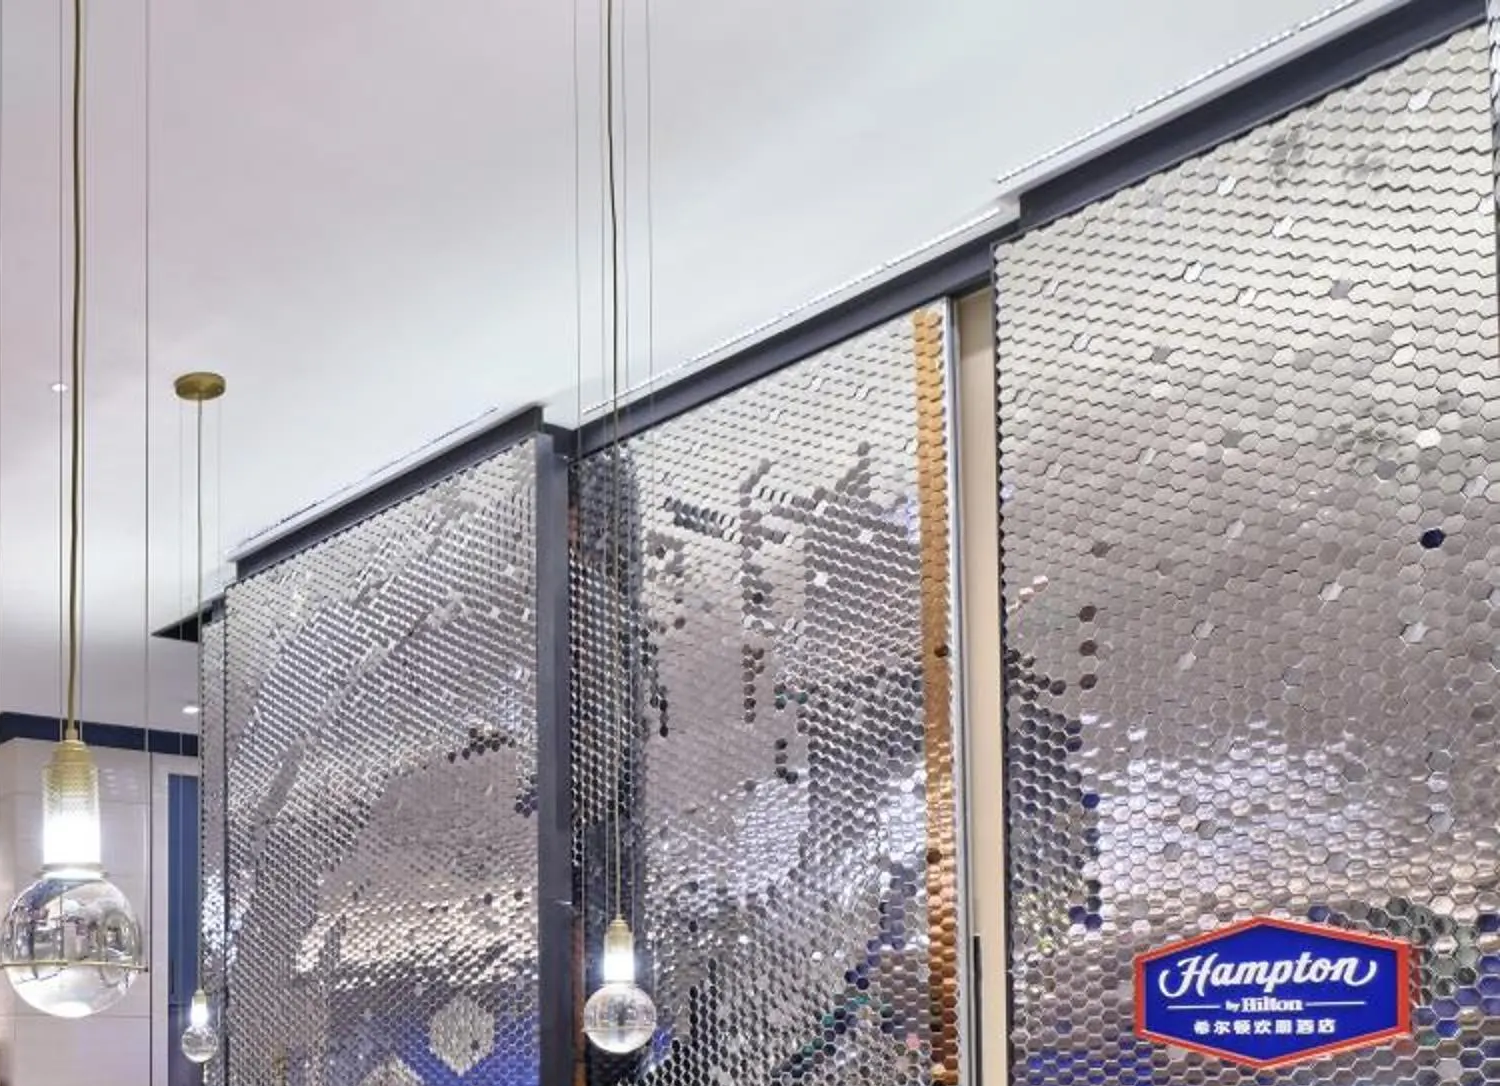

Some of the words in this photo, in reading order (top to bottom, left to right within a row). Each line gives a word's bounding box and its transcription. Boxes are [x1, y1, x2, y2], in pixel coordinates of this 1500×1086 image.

[1158, 952, 1377, 997] Hampton
[1225, 1000, 1240, 1012] by
[1241, 997, 1303, 1012] Hilton
[1193, 1018, 1336, 1035] 希尔顿欢朋酒店
